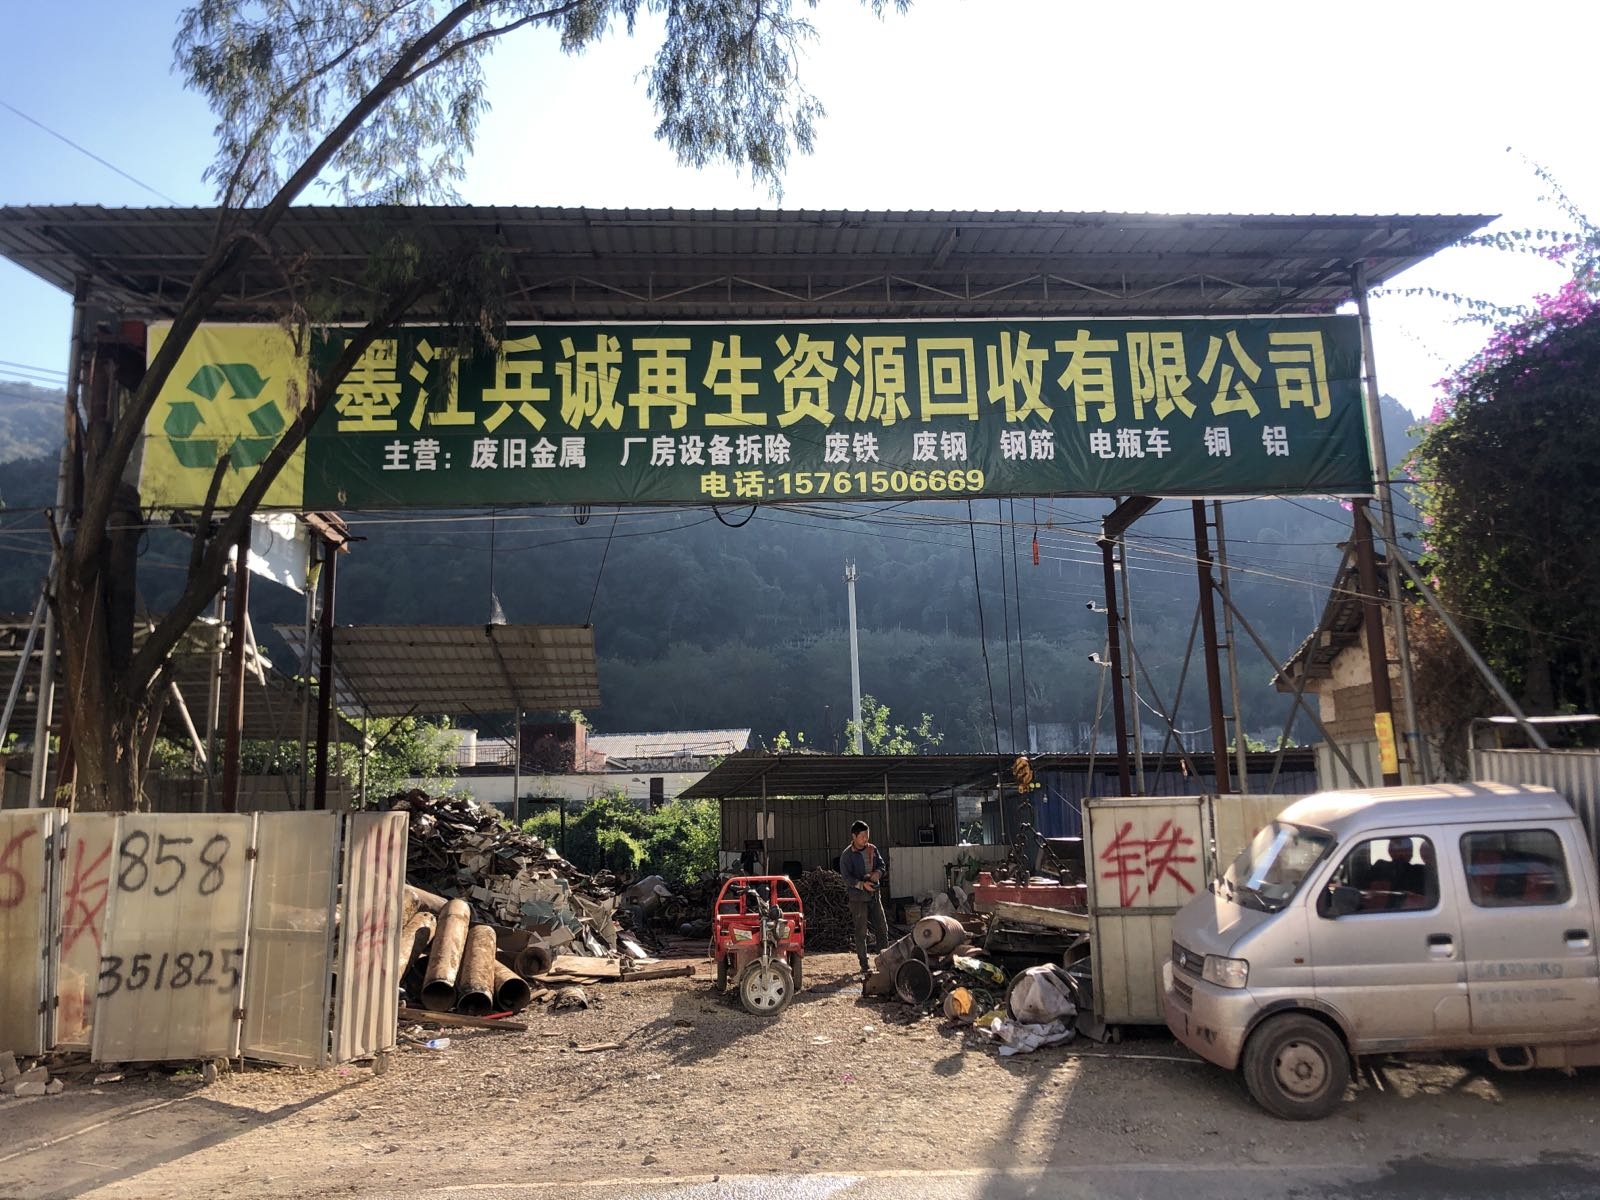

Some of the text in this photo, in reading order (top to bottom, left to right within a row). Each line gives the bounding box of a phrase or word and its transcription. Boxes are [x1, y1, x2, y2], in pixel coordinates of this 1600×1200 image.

[334, 329, 1331, 433] 墨江兵诚再生资源回收有限公司
[470, 436, 587, 469] 废旧金属
[620, 433, 792, 467] 厂房设备拆除
[824, 431, 880, 465] 废铁
[912, 430, 967, 463] 废钢
[1000, 429, 1055, 461] 钢筋
[1090, 426, 1172, 459] 电瓶车
[1204, 427, 1231, 457] 铜
[1262, 426, 1289, 457] 铝
[701, 469, 985, 497] 电话:15761506669
[117, 830, 231, 897] 858
[1100, 819, 1196, 908] 铁
[96, 947, 244, 999] 351825
